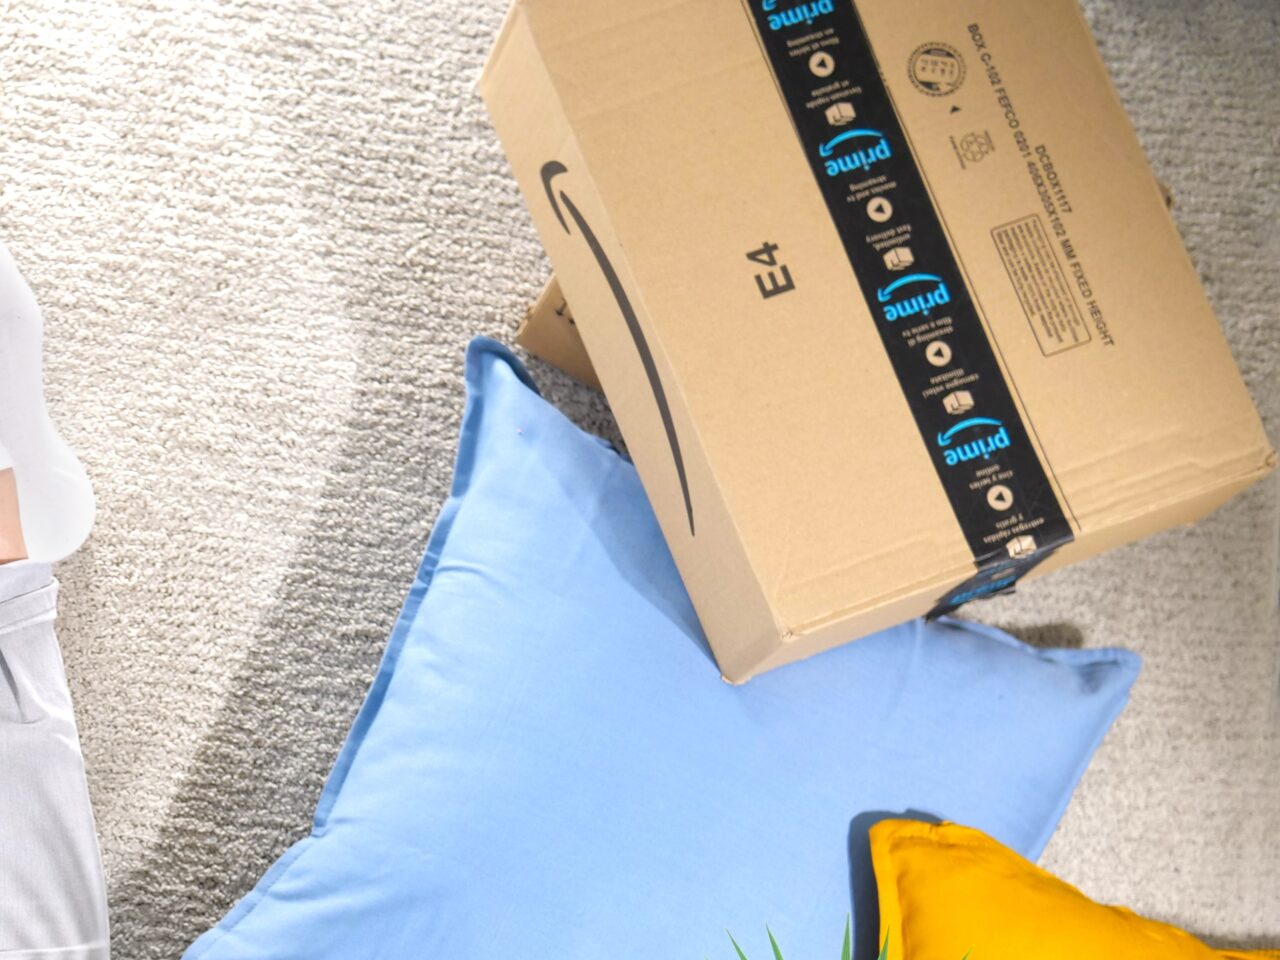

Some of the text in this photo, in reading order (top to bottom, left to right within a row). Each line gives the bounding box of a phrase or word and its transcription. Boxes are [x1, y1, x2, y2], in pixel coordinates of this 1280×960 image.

[767, 0, 834, 30] prime
[824, 138, 891, 176] prime
[967, 23, 987, 52] BOX
[980, 52, 1002, 87] C-102
[995, 87, 1020, 129] FEFCO
[1014, 130, 1032, 158] 0201
[1061, 238, 1077, 261] MM
[1070, 260, 1093, 298] FIXED
[1086, 299, 1115, 346] HEIGHT
[1035, 144, 1072, 213] DCBOX1117
[745, 241, 796, 299] E4
[883, 282, 951, 321] prime
[943, 426, 1011, 466] prime
